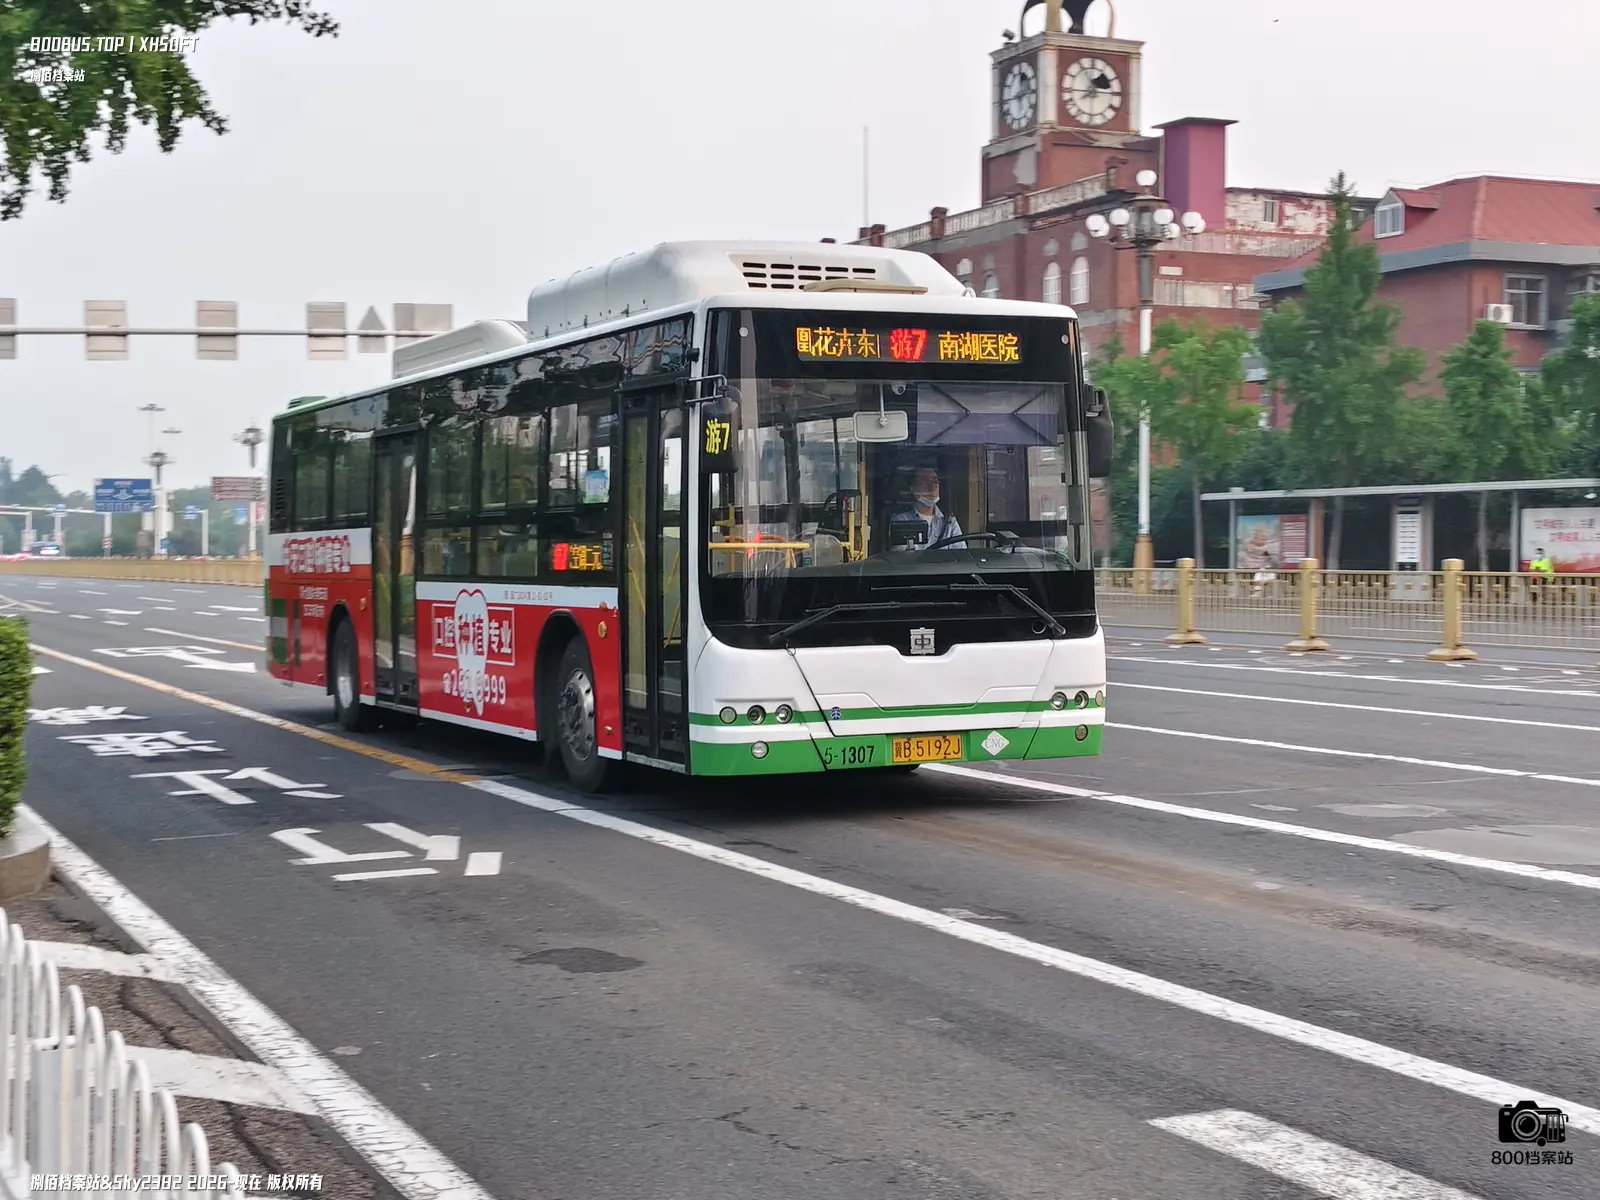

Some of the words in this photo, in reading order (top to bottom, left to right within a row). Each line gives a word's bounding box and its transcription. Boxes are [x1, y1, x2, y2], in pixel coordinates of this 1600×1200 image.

[796, 327, 881, 358] 凰花卉东
[890, 328, 927, 360] 游7
[938, 331, 1019, 361] 南湖医院
[706, 418, 730, 454] 游7
[433, 612, 513, 657] 口腔种植专业
[824, 744, 875, 765] 5-1307
[984, 737, 1004, 749] CNG
